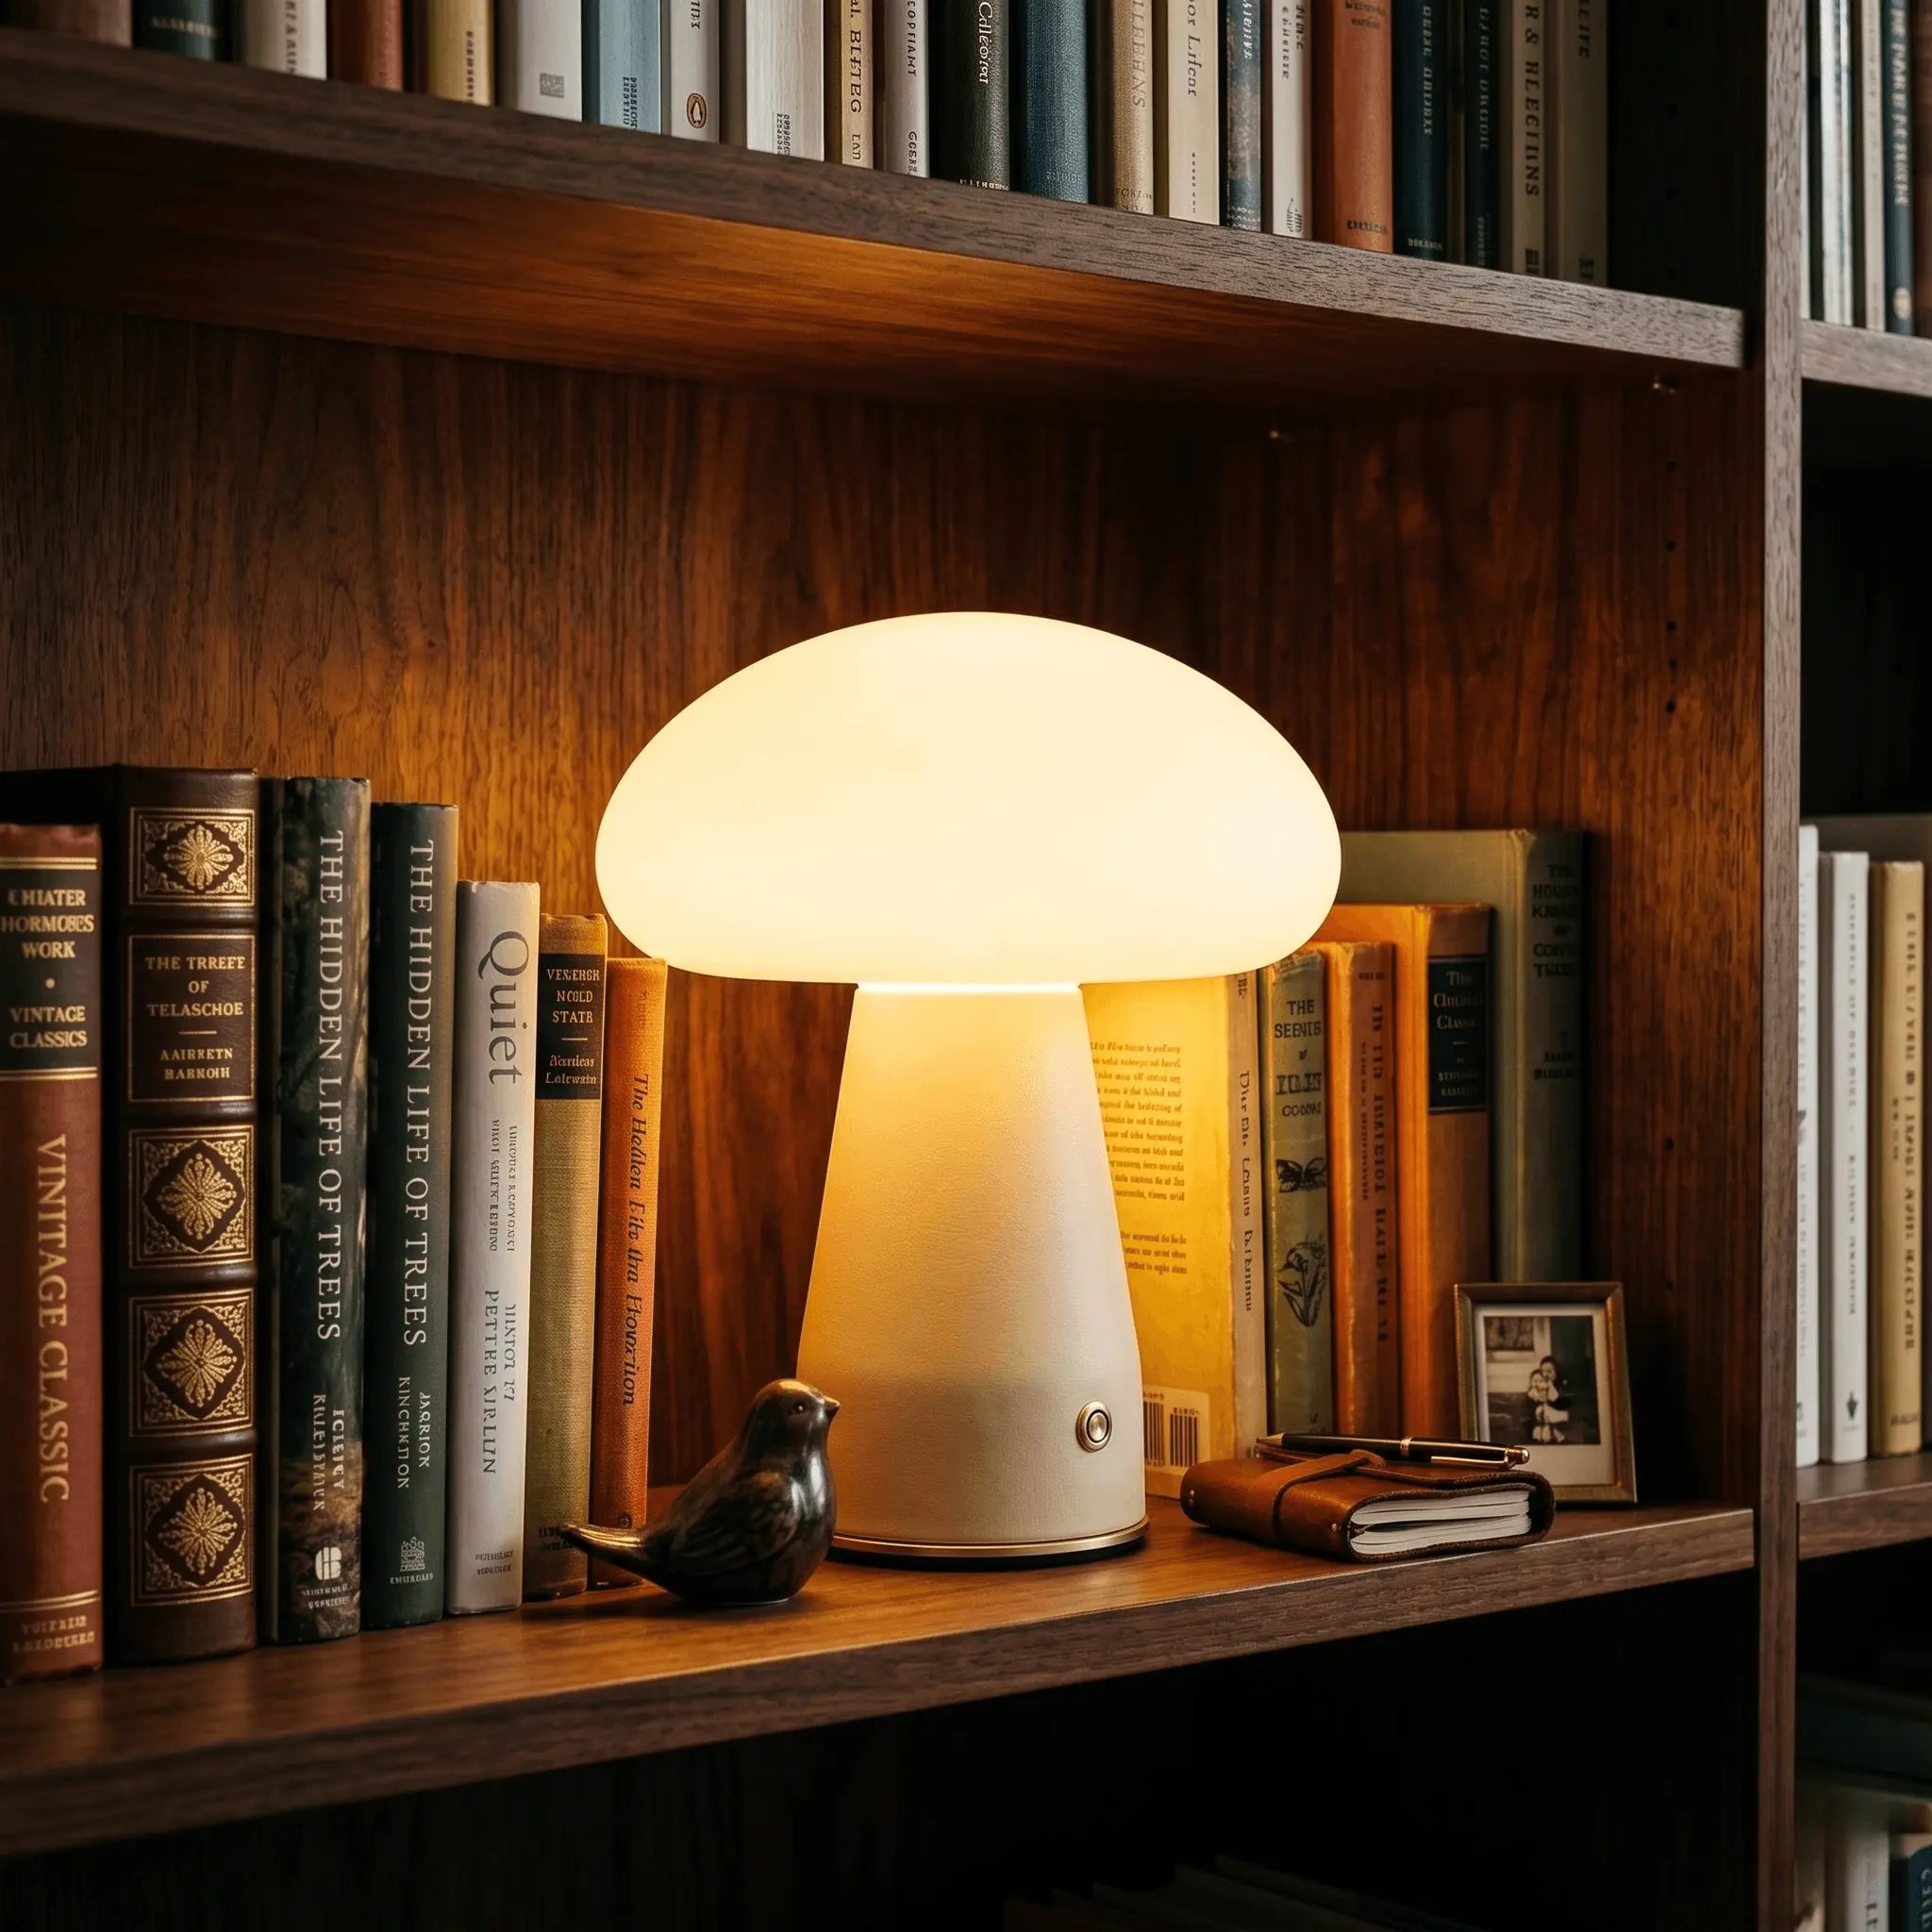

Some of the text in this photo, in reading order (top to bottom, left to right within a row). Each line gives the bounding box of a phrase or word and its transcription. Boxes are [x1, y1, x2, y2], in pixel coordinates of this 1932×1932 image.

[22, 941, 76, 959] WORK
[144, 957, 181, 970] THE
[188, 980, 209, 993] OF
[9, 1006, 87, 1024] VINTAGE
[477, 930, 530, 1085] Quiet
[1286, 999, 1315, 1016] THE
[9, 1030, 88, 1049] CLASSICS
[317, 829, 343, 1341] THE HIDDEN LIFE OF TREES
[403, 839, 434, 1346] THE HIDDEN LIFE OF TREES
[39, 1340, 70, 1504] CLASSIC
